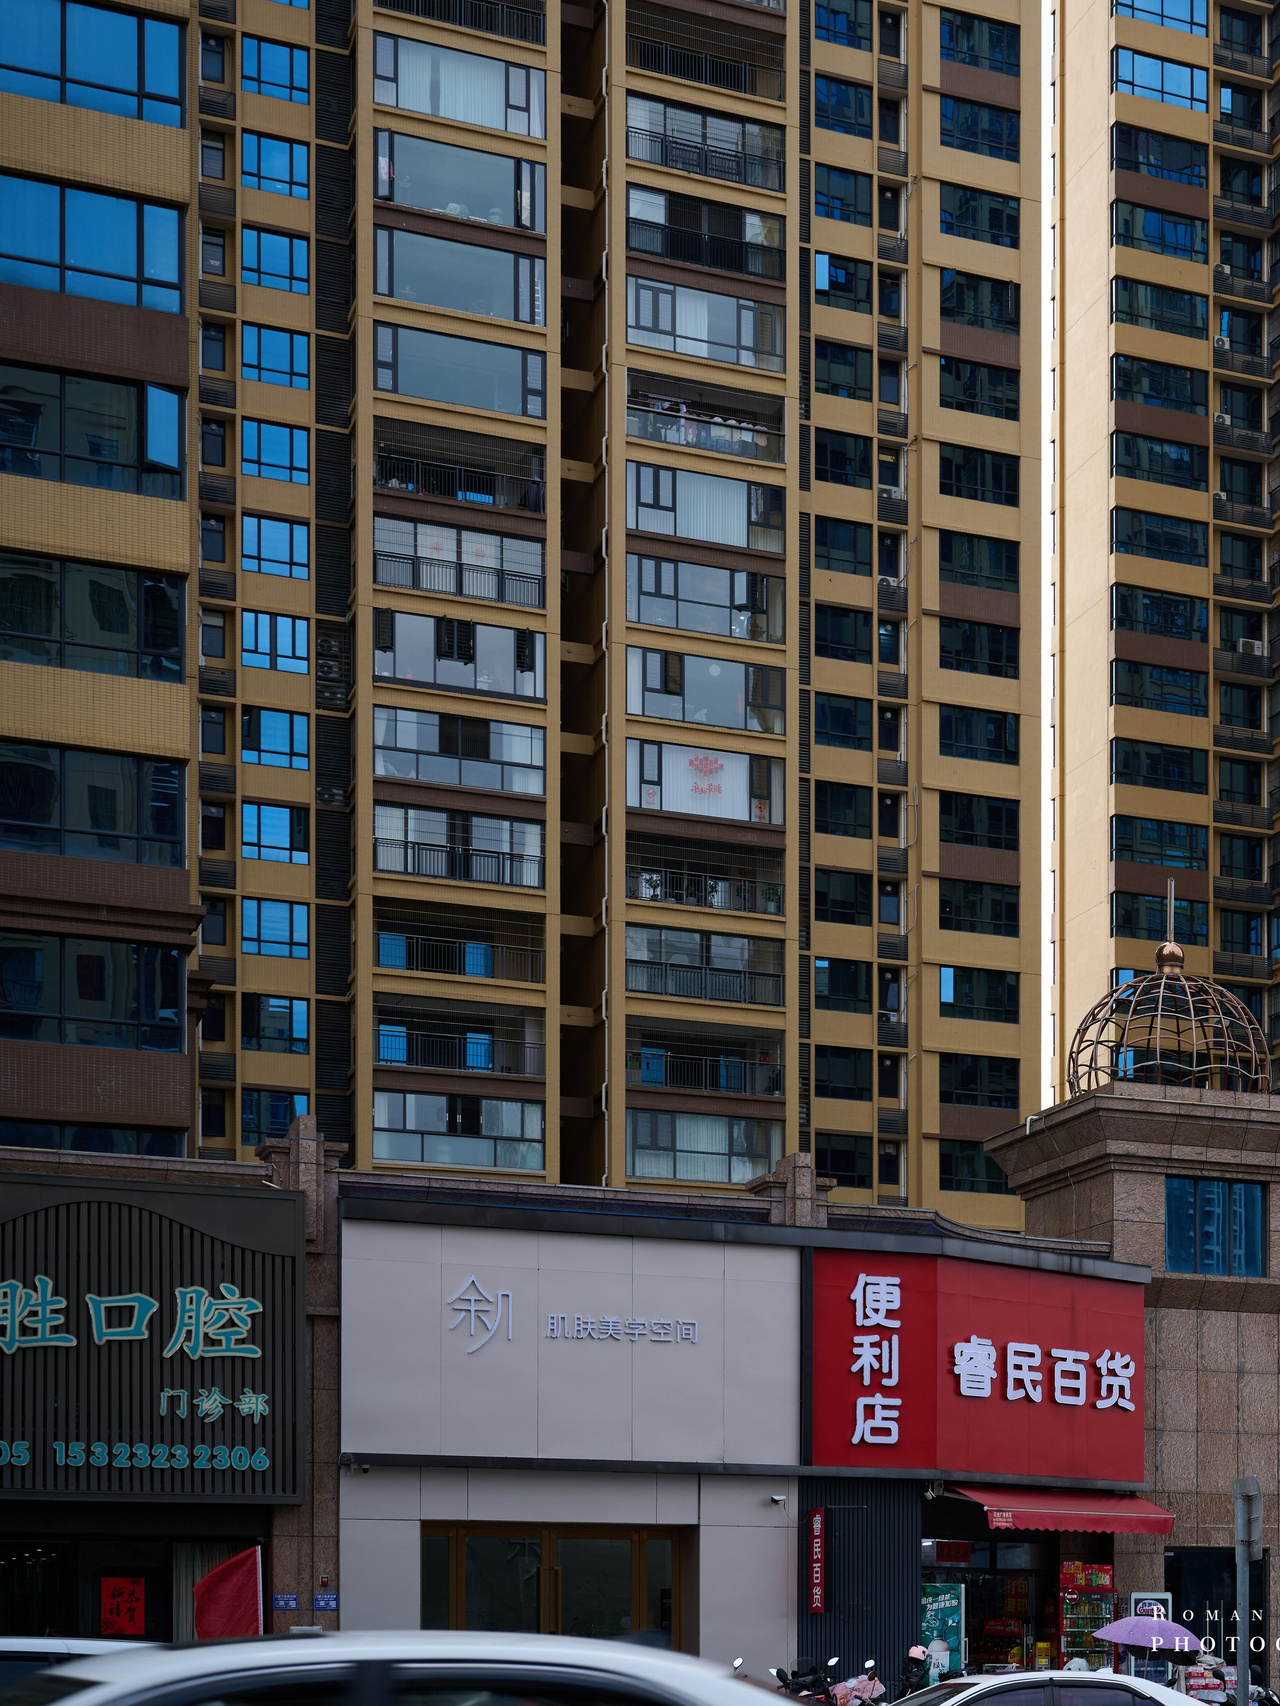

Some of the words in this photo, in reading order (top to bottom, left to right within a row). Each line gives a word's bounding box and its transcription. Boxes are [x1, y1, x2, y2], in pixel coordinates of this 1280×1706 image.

[0, 1274, 263, 1360] 胜口腔
[545, 1313, 698, 1344] 肌肤美学空间
[850, 1273, 902, 1445] 便利店
[953, 1334, 1136, 1411] 睿民百货
[159, 1386, 269, 1424] 门诊部
[53, 1441, 270, 1471] 15323232306
[812, 1513, 822, 1608] 睿民百货
